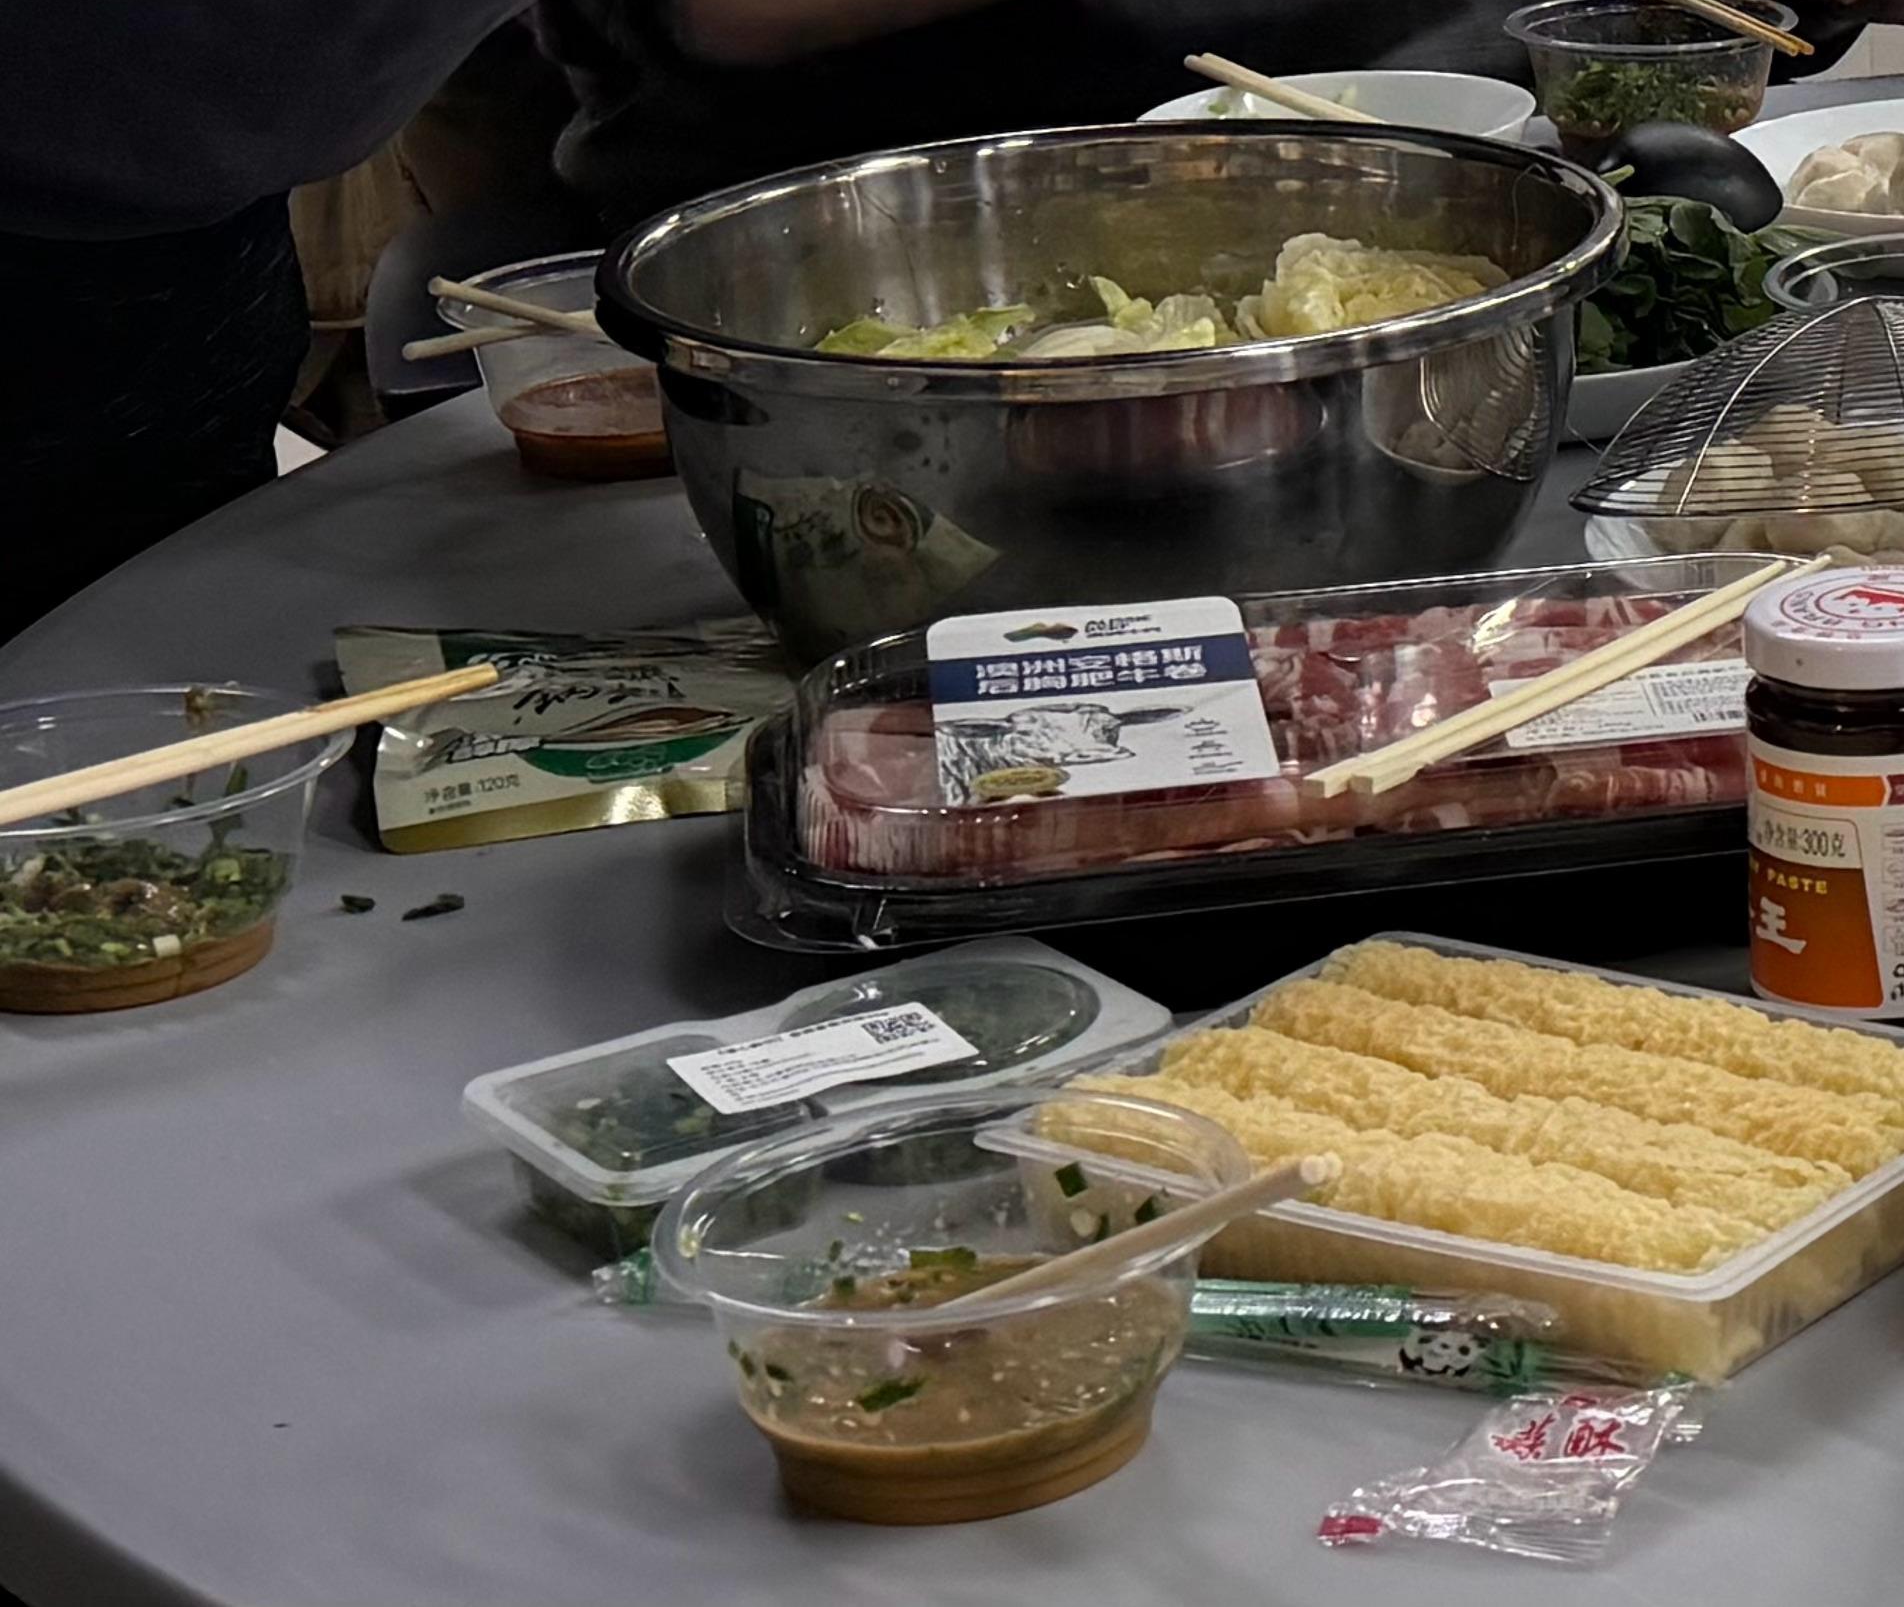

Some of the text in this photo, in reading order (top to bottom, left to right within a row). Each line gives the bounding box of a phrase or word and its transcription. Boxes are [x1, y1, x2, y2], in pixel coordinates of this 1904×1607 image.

[975, 644, 1203, 680] 澳洲安格斯
[977, 663, 1207, 696] 后胸肥牛卷
[1766, 868, 1828, 895] PASTE
[1753, 896, 1807, 955] 王
